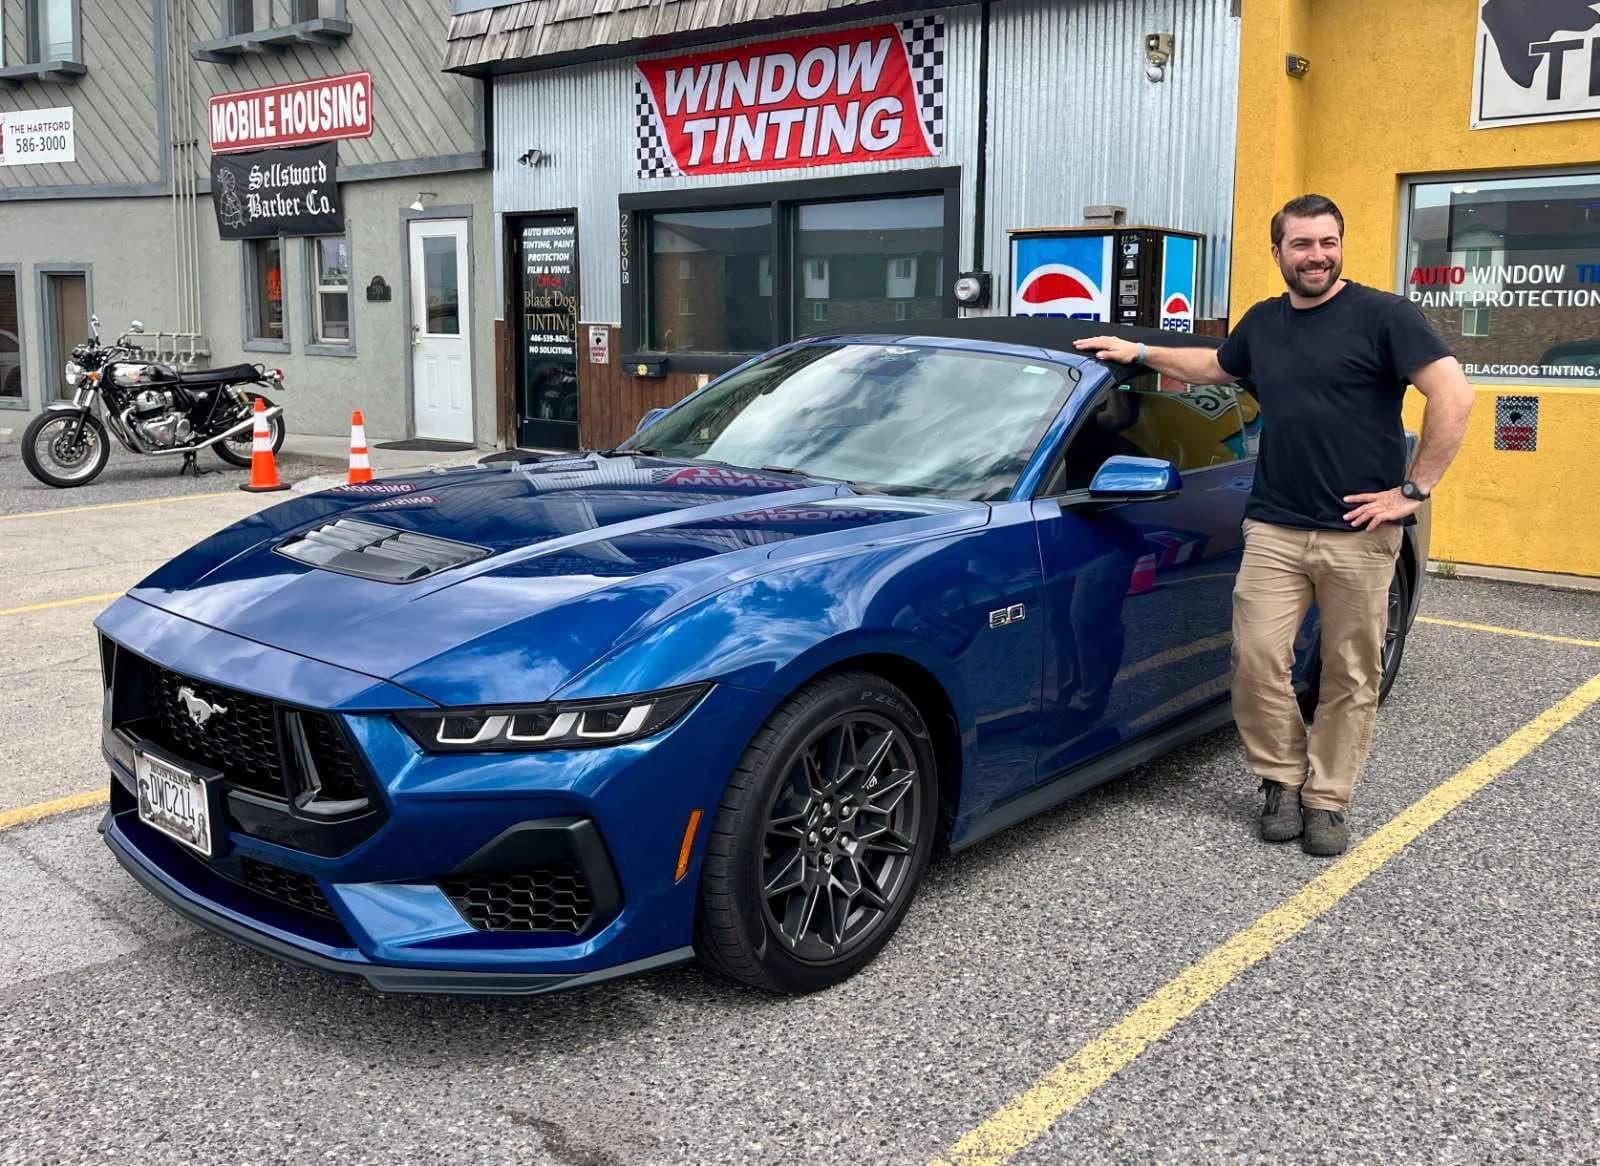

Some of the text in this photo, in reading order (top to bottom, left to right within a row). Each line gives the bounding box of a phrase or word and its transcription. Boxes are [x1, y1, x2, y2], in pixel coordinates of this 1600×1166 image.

[664, 38, 892, 117] WINDOW
[211, 81, 367, 144] MOBILE HOUSING
[10, 121, 71, 134] THE HARTFORD
[682, 96, 904, 166] TINTING
[16, 135, 66, 153] 586-3000
[248, 160, 327, 191] Sellsword
[246, 189, 336, 222] Barber Co.
[523, 226, 574, 237] AUTO WINDOW
[523, 239, 575, 249] TINTING, PAINT
[528, 252, 570, 262] PROTECTION
[527, 265, 543, 274] FILM
[551, 265, 571, 274] VINYL
[1409, 266, 1465, 285] AUTO
[1472, 264, 1565, 284] WINDOW
[524, 289, 576, 313] Black Dog
[1410, 291, 1465, 308] PAINT
[524, 313, 576, 334] TINTING
[1162, 318, 1191, 332] PEPSI
[539, 346, 573, 354] SOLICITING
